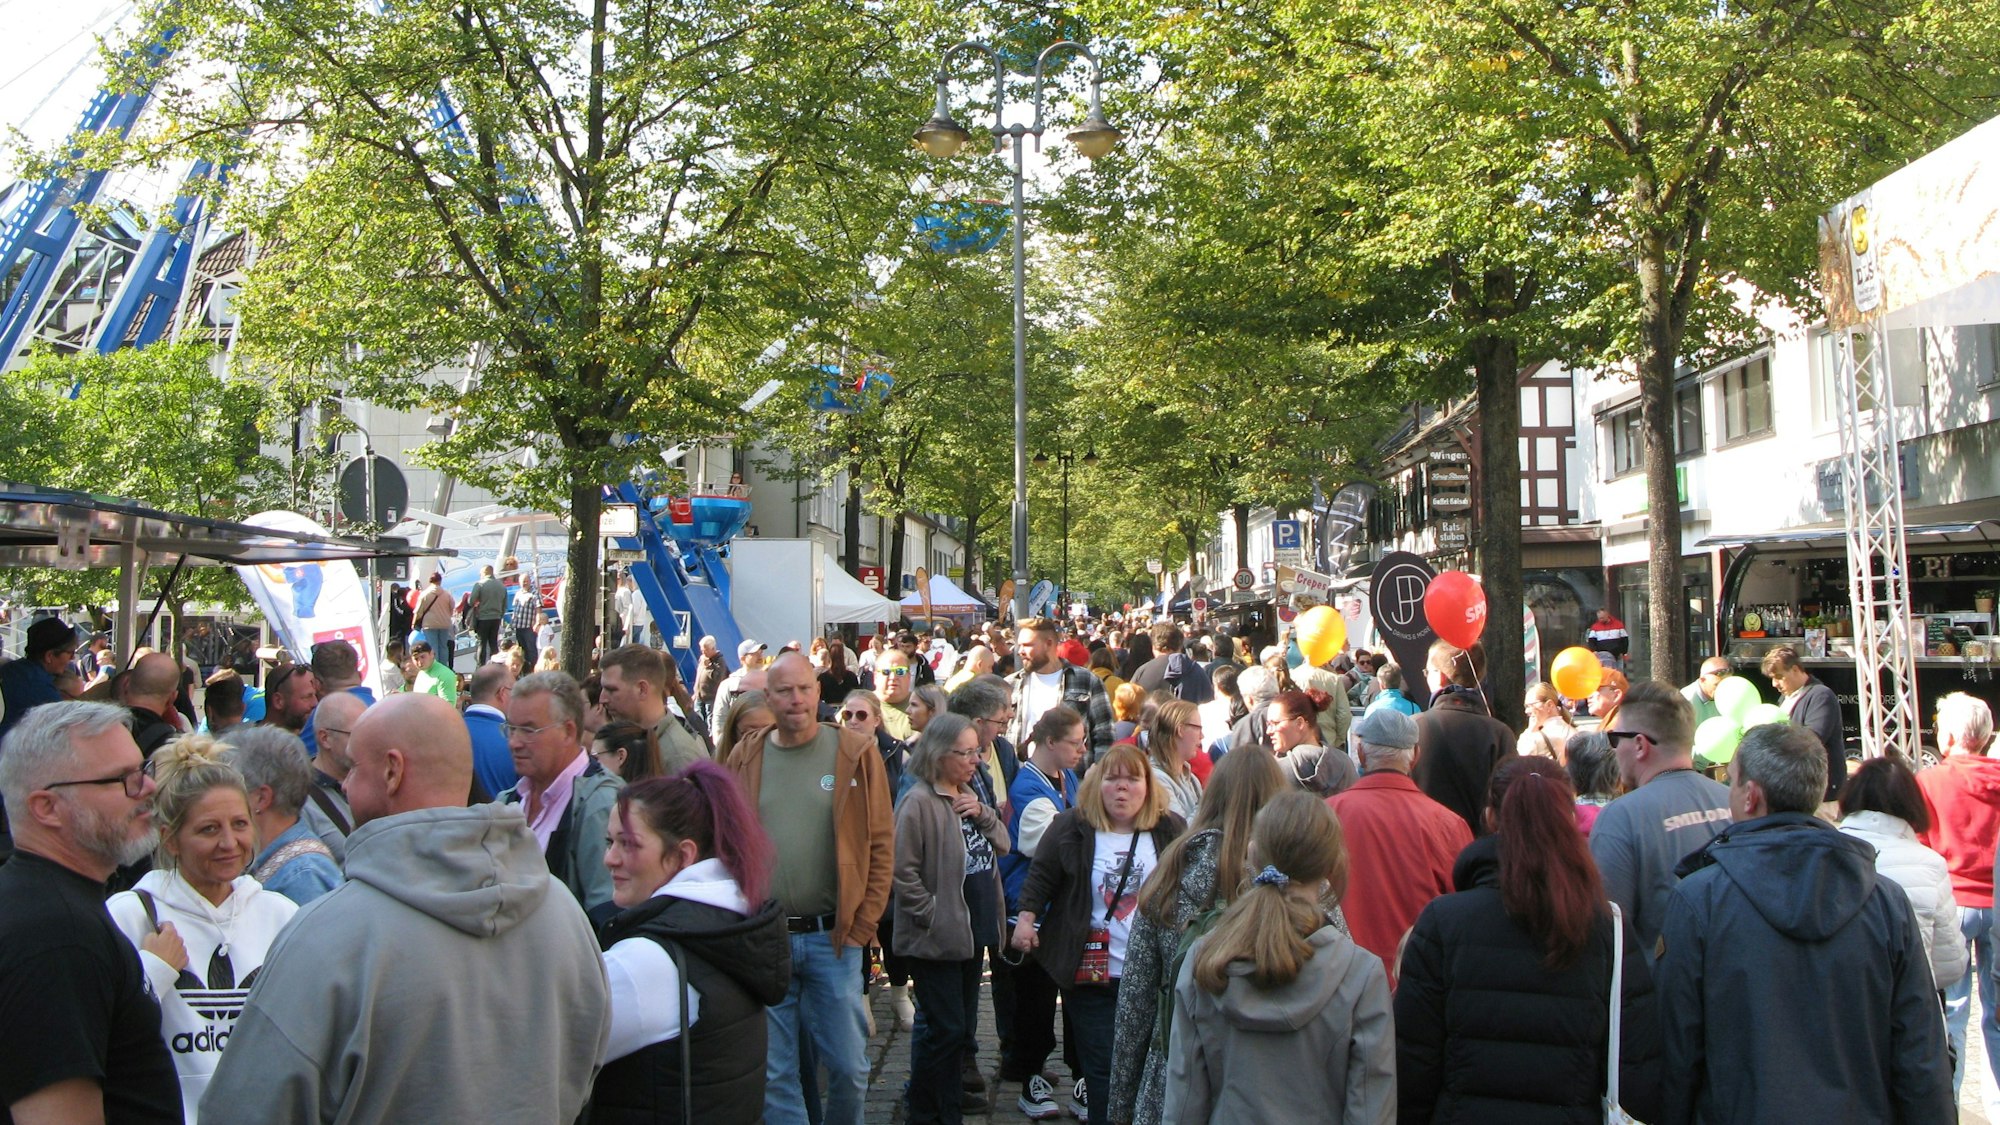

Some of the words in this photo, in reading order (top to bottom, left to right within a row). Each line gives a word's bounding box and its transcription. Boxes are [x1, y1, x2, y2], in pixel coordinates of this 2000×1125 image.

[1278, 523, 1294, 545] P
[1442, 522, 1460, 532] Rats
[1238, 574, 1250, 586] 30
[1663, 807, 1733, 832] SMILOD
[172, 1025, 234, 1053] adid
